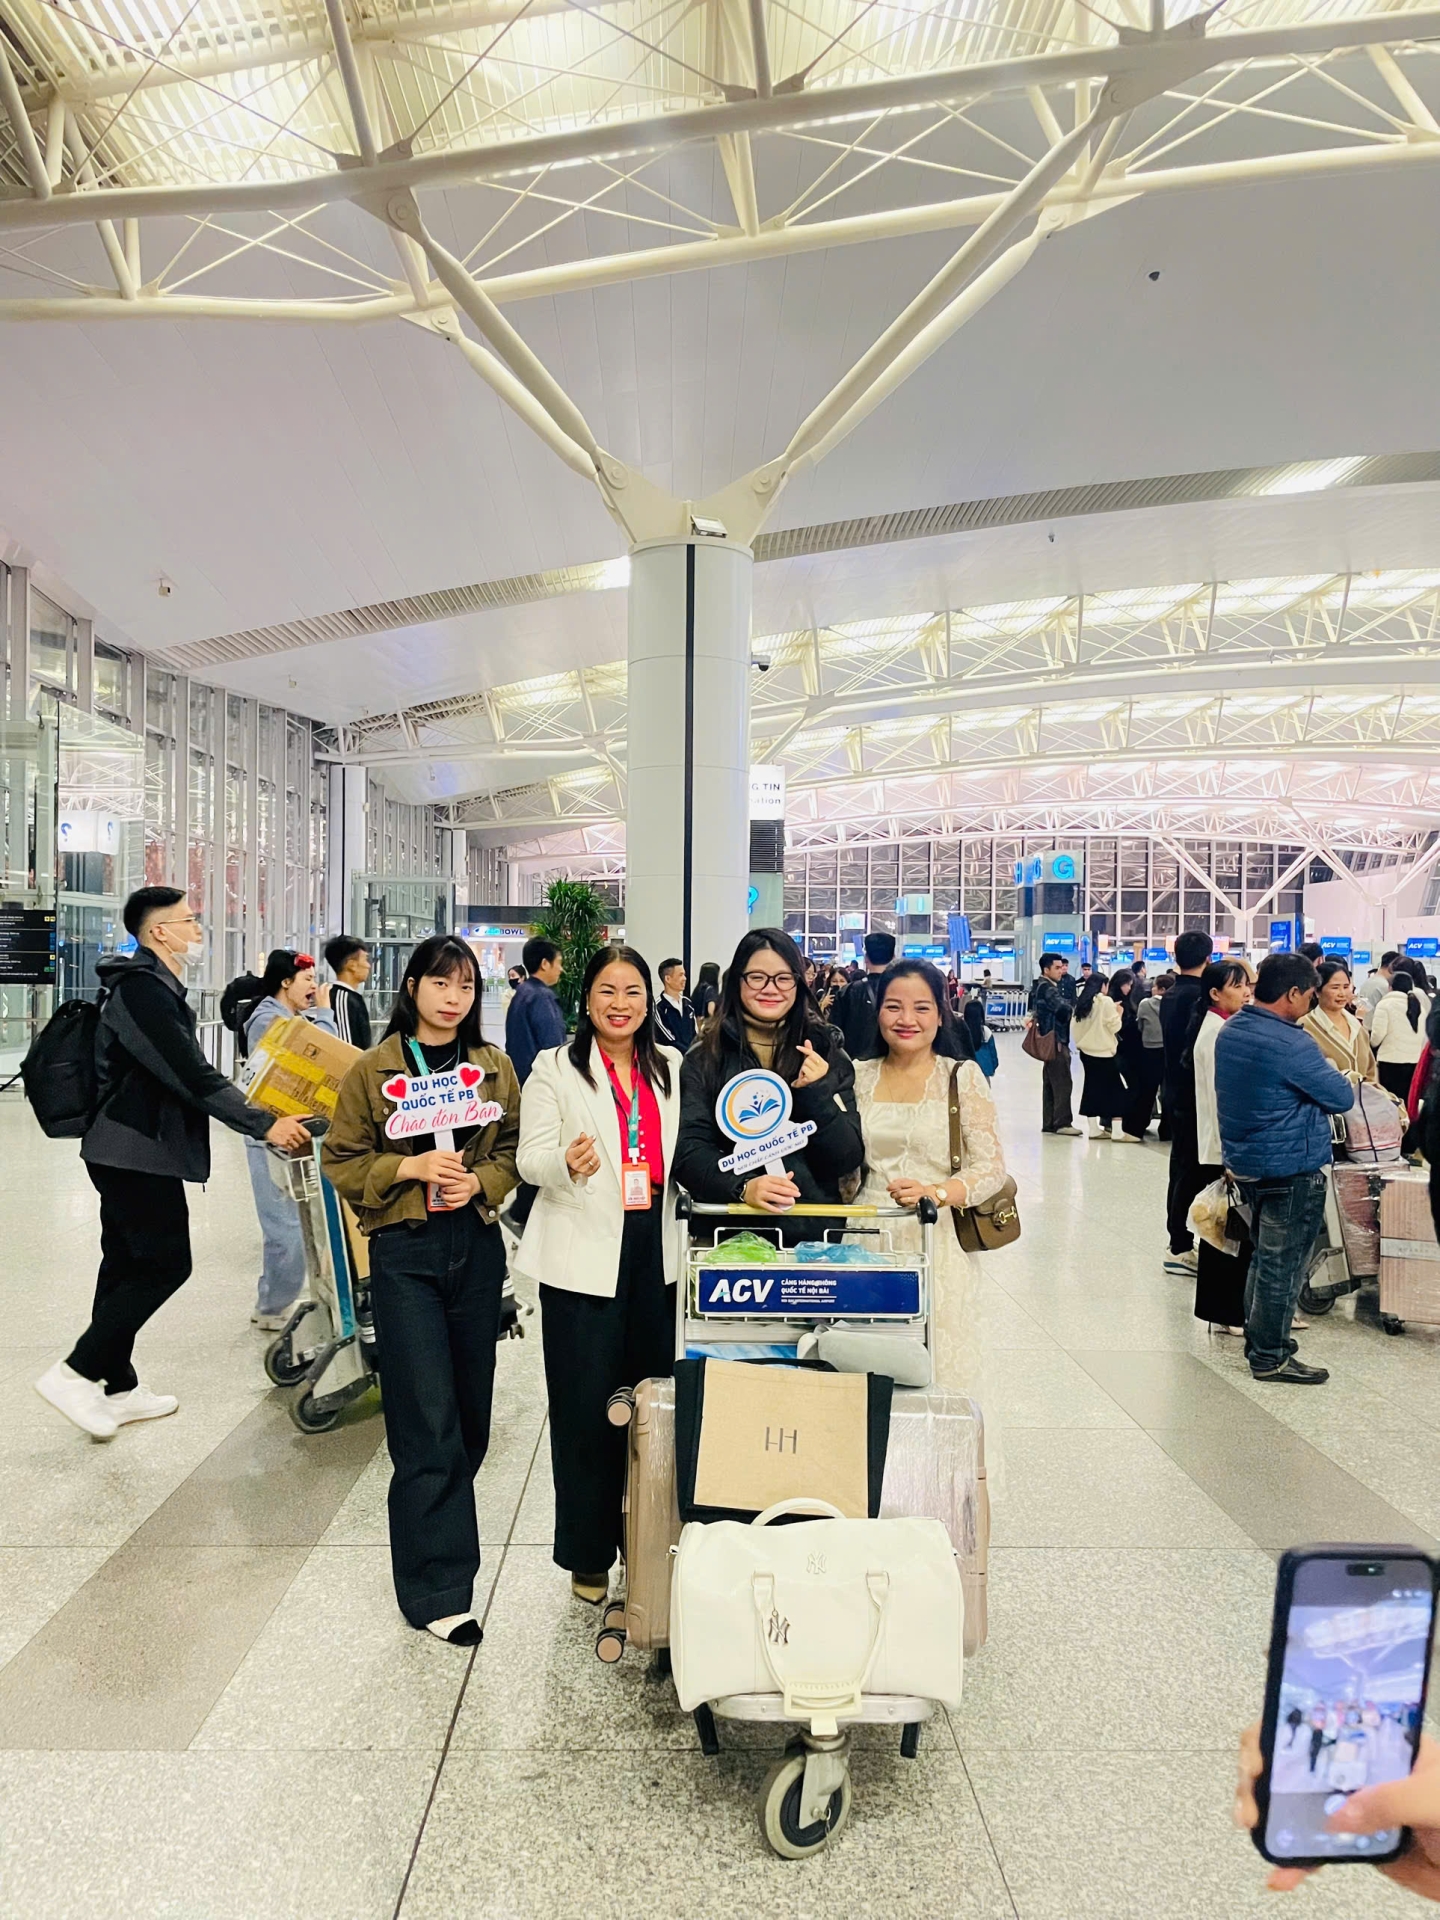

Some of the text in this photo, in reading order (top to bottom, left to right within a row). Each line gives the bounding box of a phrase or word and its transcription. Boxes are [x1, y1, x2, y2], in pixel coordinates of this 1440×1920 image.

[1052, 855, 1075, 879] G
[411, 1076, 458, 1092] DU HỌC
[401, 1088, 474, 1111] QUỐC TẾ PB
[389, 1114, 427, 1135] Chào
[431, 1108, 459, 1128] đón
[721, 1124, 814, 1168] DU HỌC QUỐC TẾ PB
[708, 1278, 774, 1303] ACV
[781, 1286, 797, 1295] QUỐC
[798, 1286, 806, 1294] TẾ
[807, 1286, 818, 1295] NỘI
